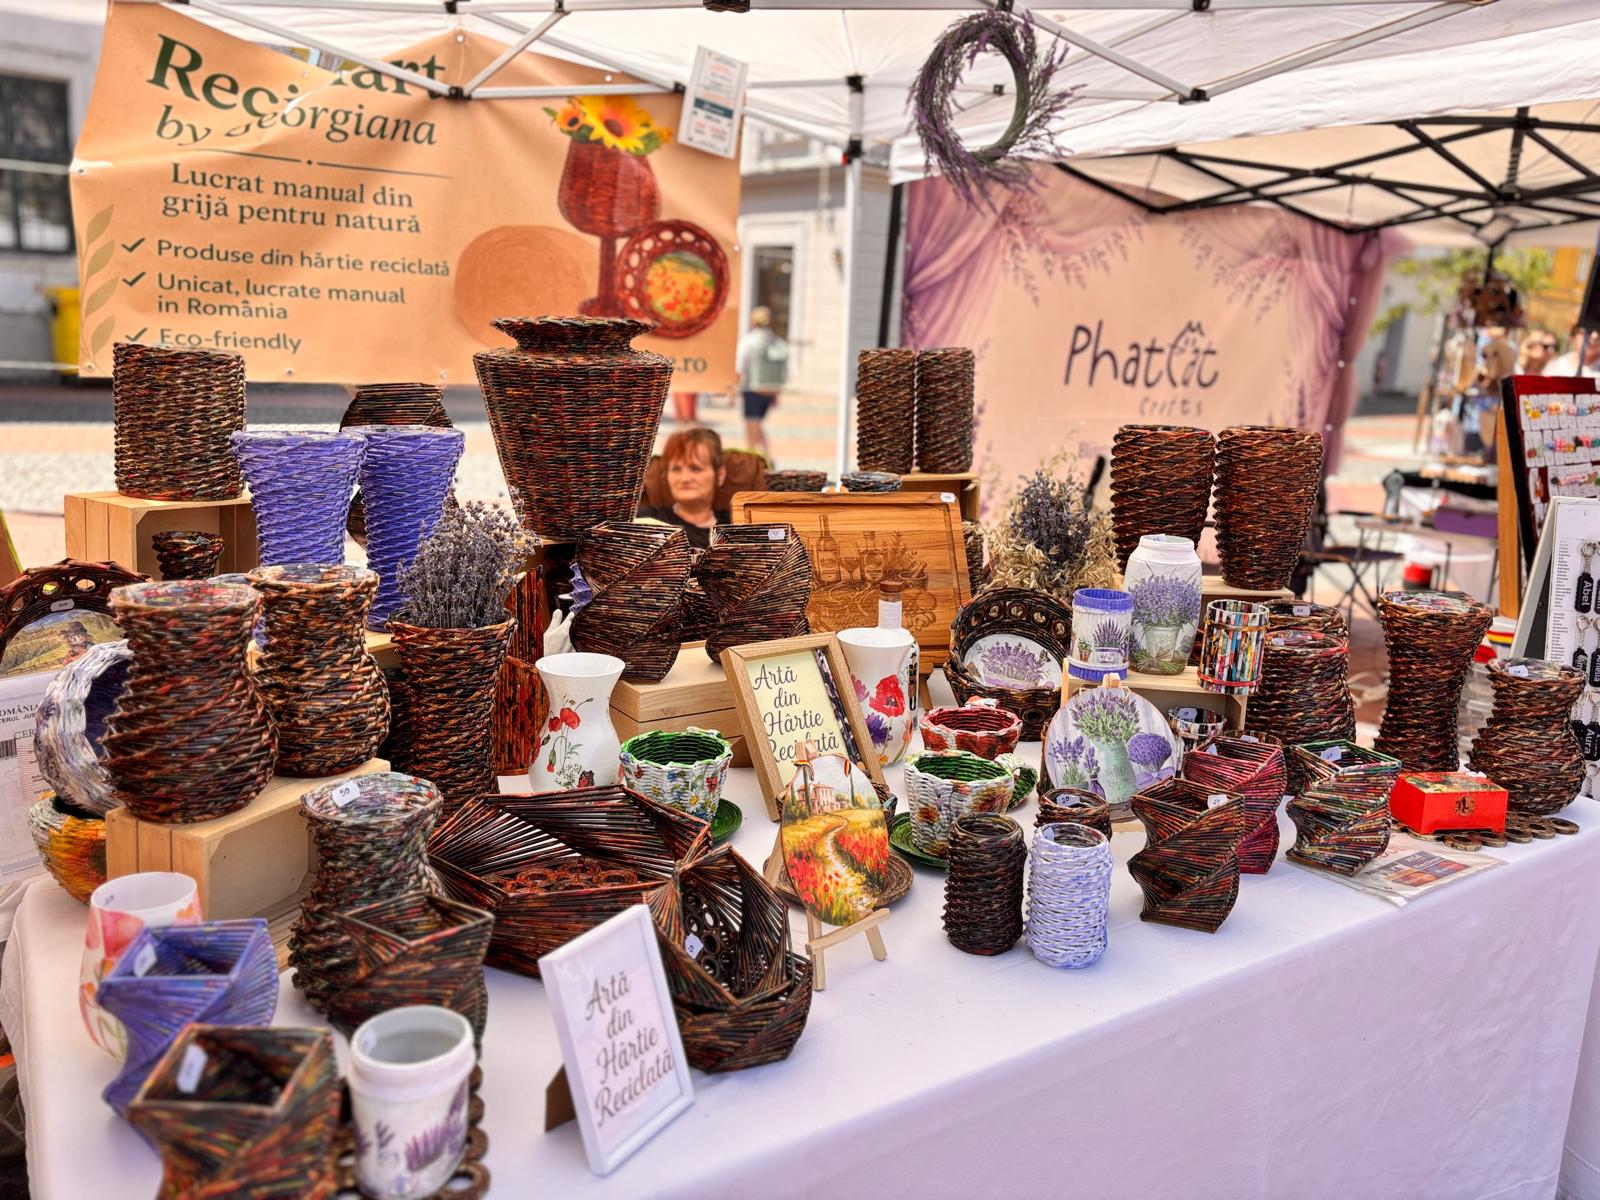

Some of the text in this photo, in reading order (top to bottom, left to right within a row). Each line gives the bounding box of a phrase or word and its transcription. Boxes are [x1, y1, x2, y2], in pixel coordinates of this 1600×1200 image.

[156, 104, 213, 147] by
[171, 162, 415, 209] Lucrat manual din
[162, 193, 423, 235] grijă pentru natură
[157, 239, 255, 265] Produse
[260, 249, 294, 267] din
[369, 258, 451, 278] reciclată
[157, 272, 406, 304] Unicat, lucrate manual
[157, 295, 289, 321] in România
[159, 328, 303, 356] Eco-friendly
[753, 663, 797, 691] Artă
[773, 687, 801, 709] din
[763, 709, 825, 737] Hârtie
[585, 971, 632, 1021] Artă
[607, 1006, 635, 1040] din
[596, 1026, 660, 1086] Hârtie
[594, 1048, 676, 1128] Reciclată
